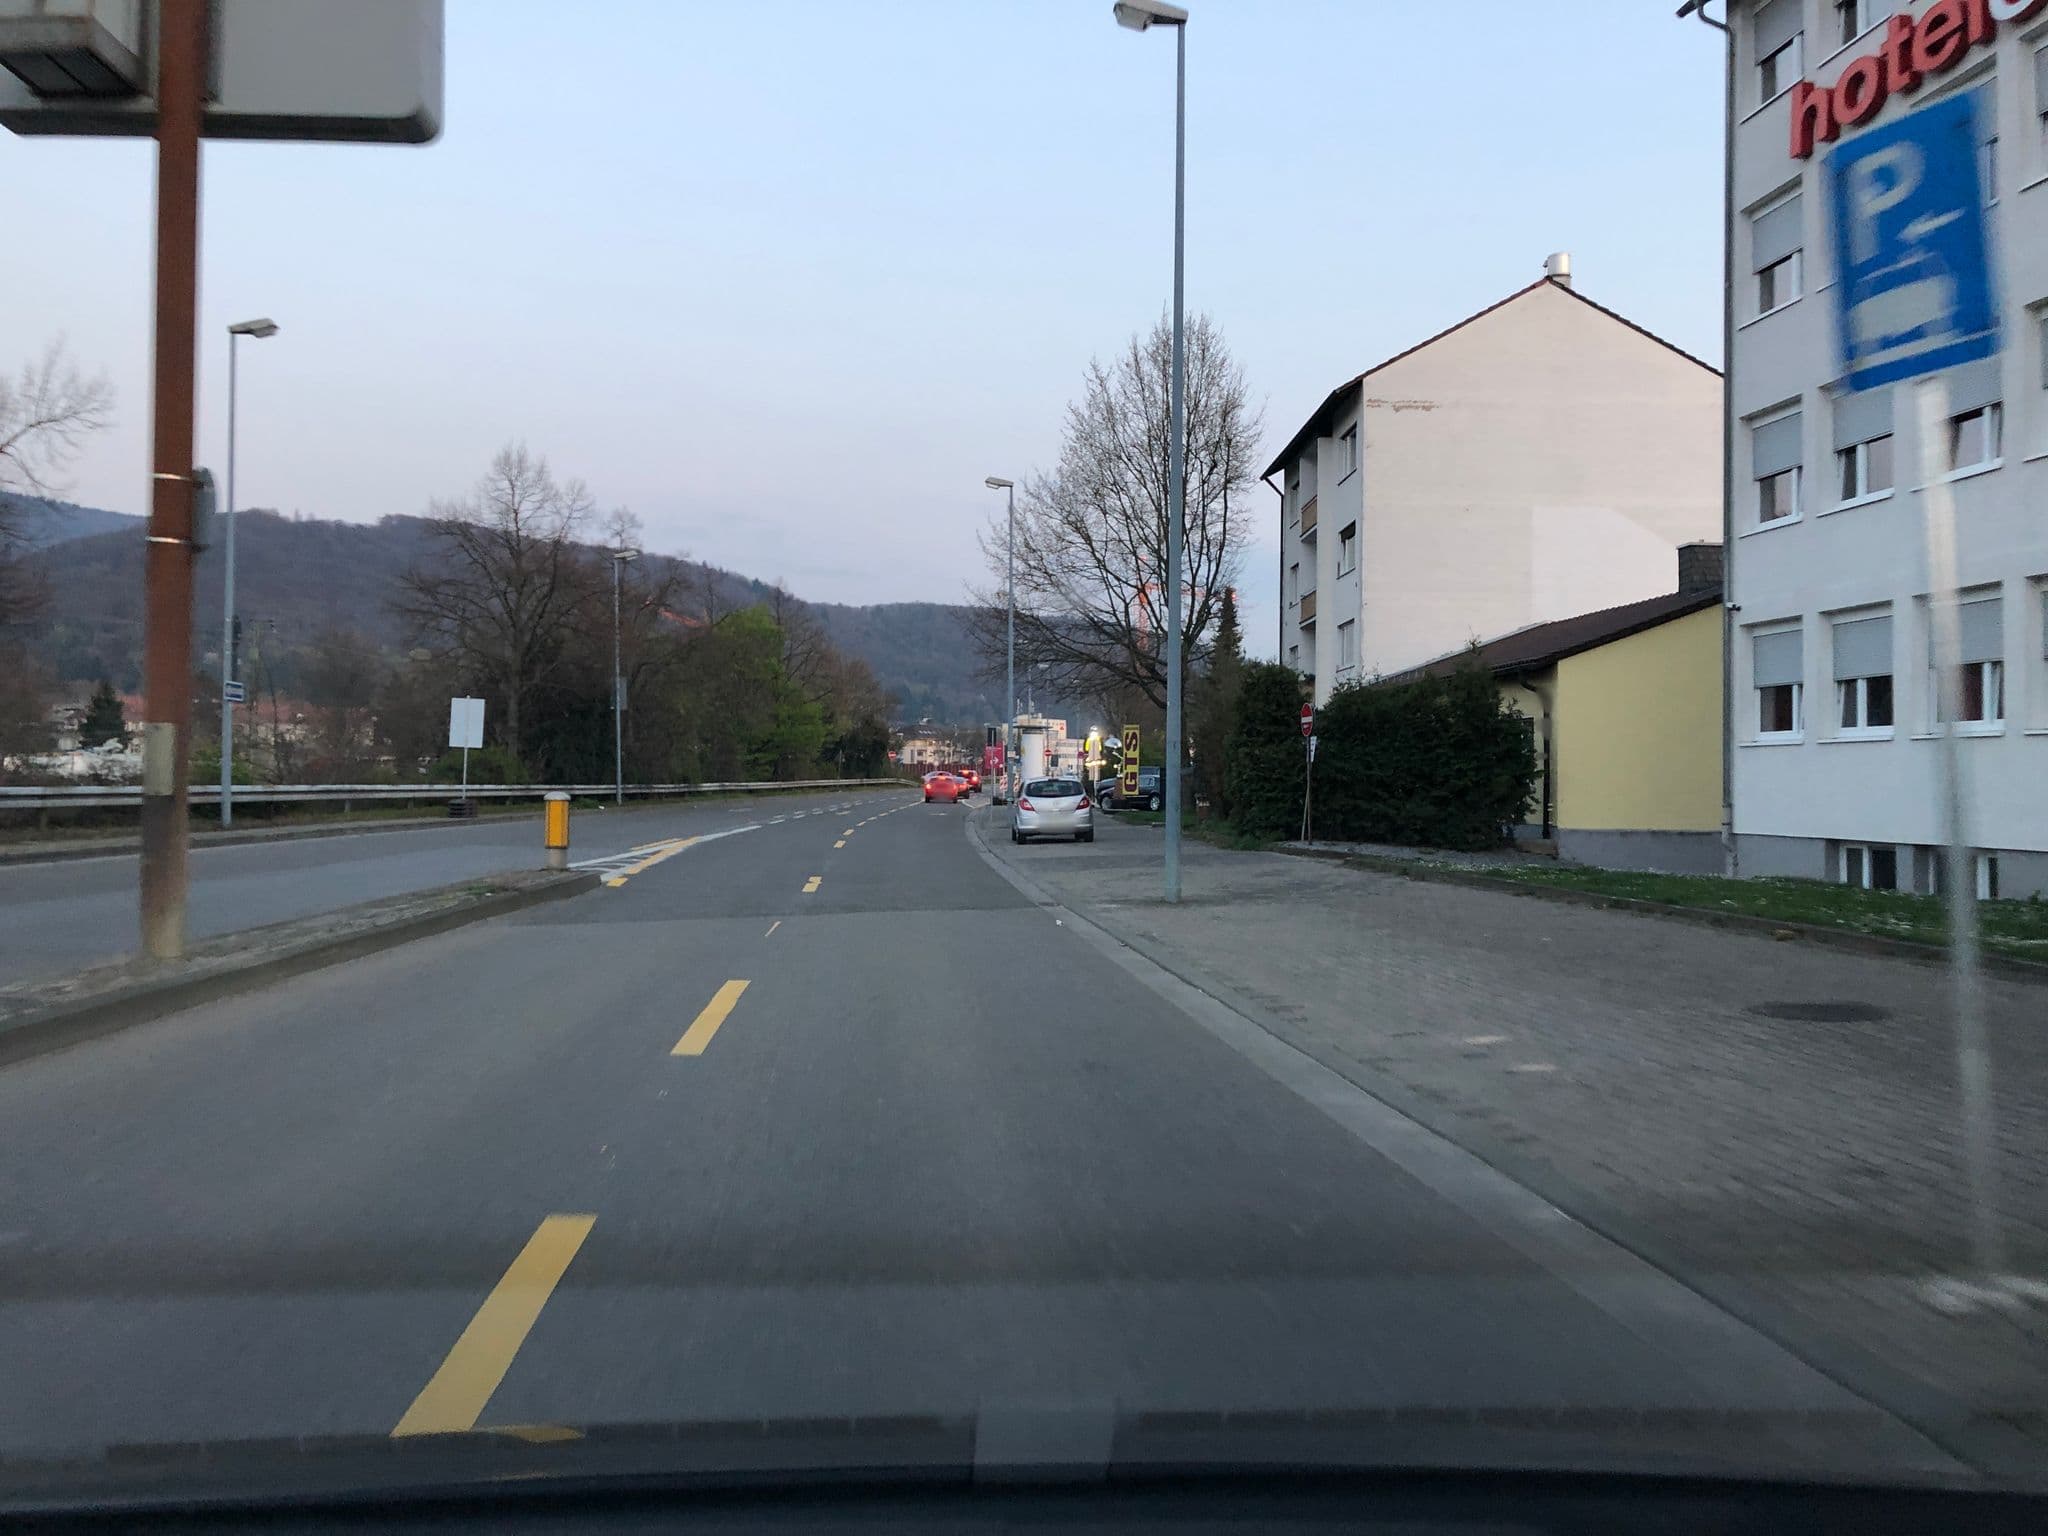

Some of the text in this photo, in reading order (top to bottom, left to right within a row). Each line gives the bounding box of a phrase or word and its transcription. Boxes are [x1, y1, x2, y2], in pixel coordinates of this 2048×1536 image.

[1790, 0, 2046, 159] hotel
[1850, 141, 1926, 267] P
[1124, 731, 1138, 791] GTS
